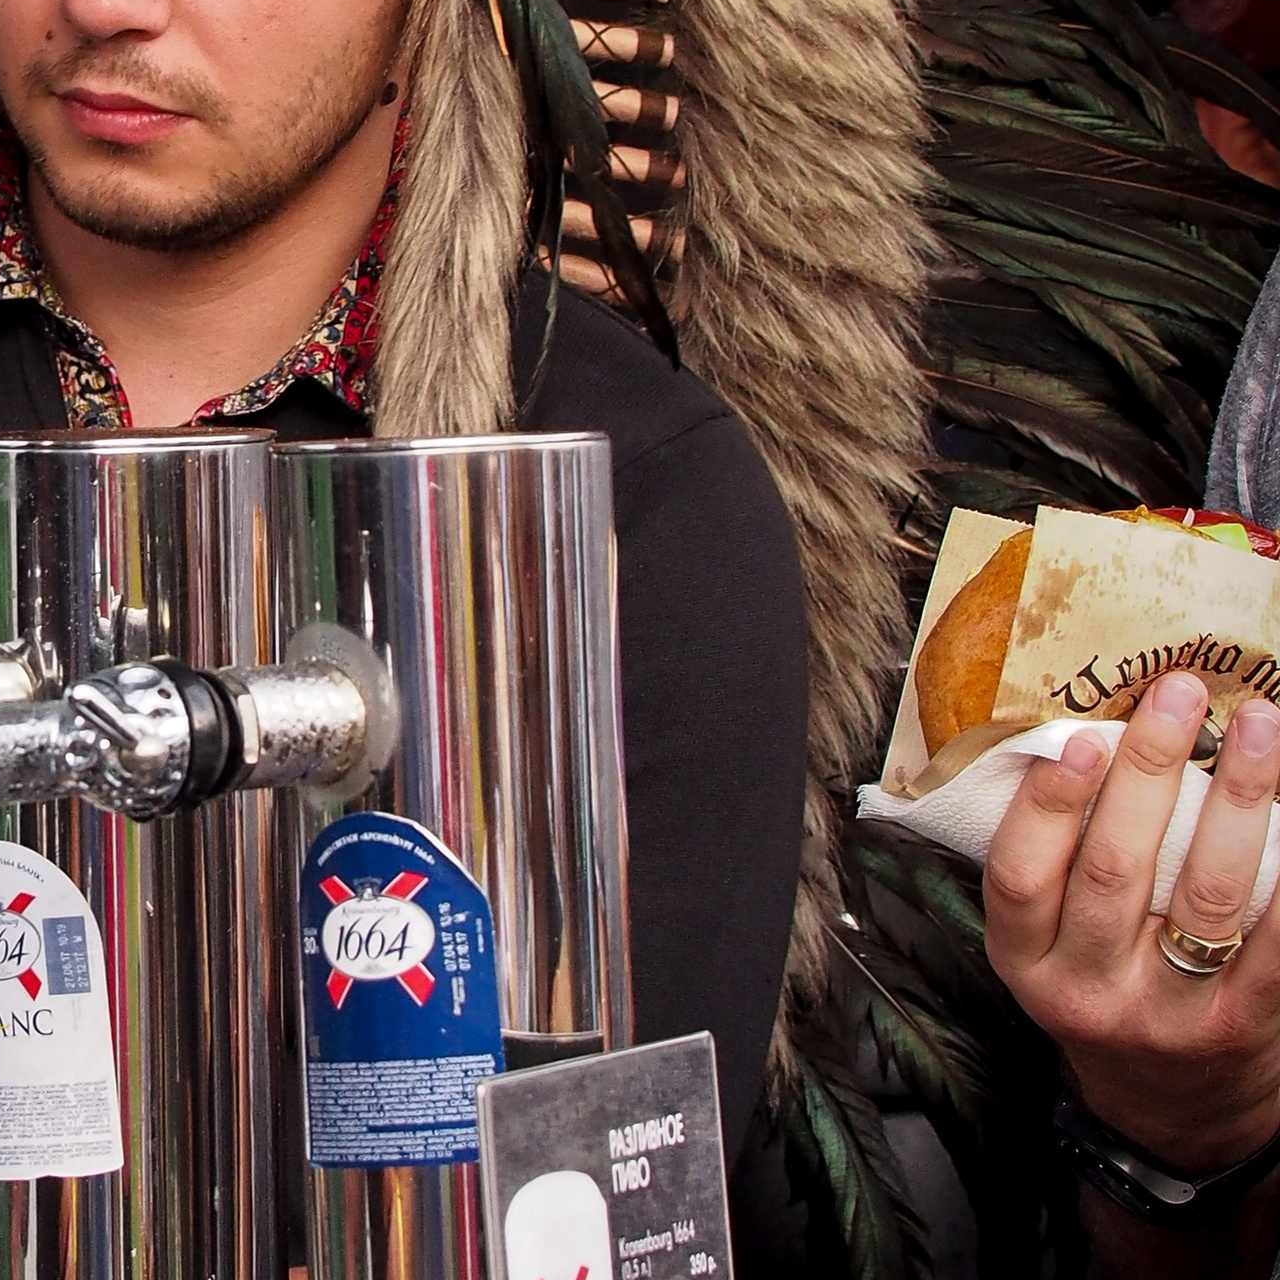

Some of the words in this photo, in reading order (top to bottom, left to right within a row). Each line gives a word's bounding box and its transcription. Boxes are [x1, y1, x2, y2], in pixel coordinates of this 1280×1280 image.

[335, 916, 414, 962] 1664
[608, 1112, 685, 1160] РАЗЛИВНОЕ
[612, 1156, 652, 1196] ПИВО
[618, 1228, 673, 1260] Kronenbourg
[672, 1218, 695, 1244] 1664
[689, 1251, 707, 1276] 350
